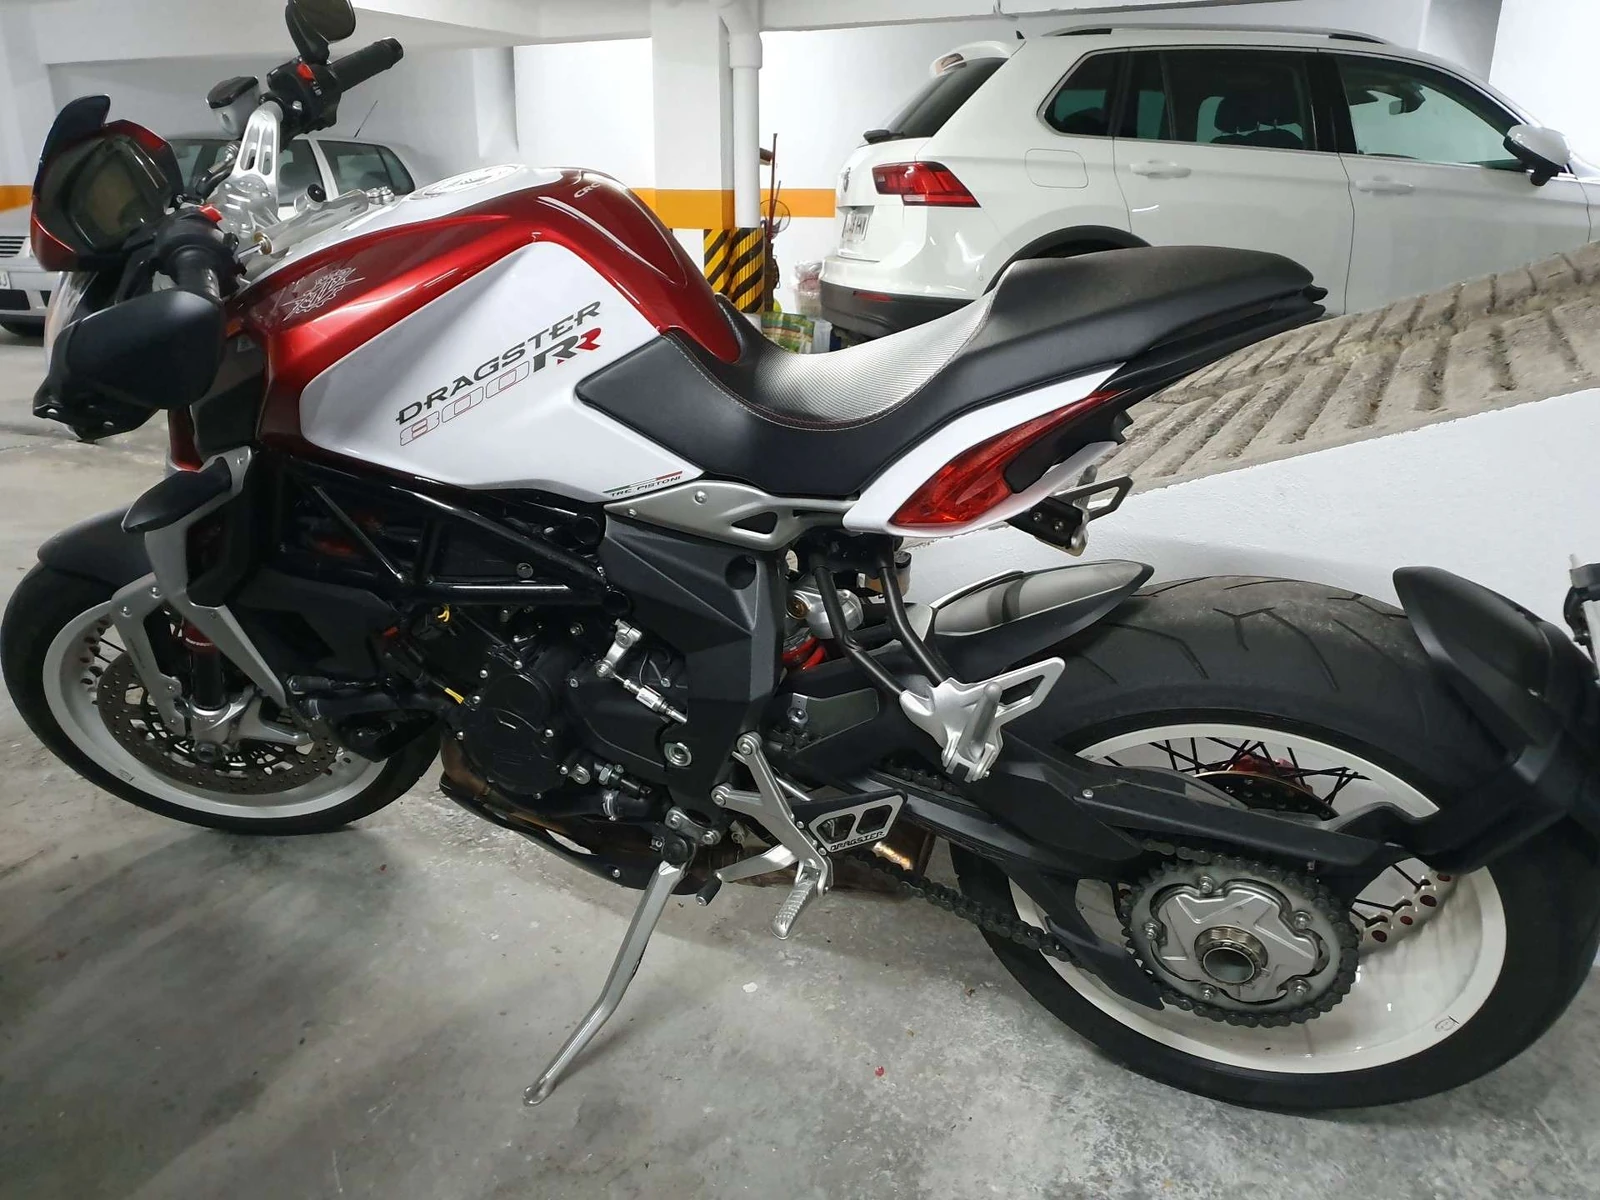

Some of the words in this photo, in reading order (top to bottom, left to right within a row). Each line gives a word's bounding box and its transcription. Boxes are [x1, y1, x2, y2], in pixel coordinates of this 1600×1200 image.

[396, 301, 601, 425] DRAGSTER
[611, 488, 632, 497] TRE
[637, 475, 681, 490] PISTONI
[830, 831, 885, 851] DRAGSTER
